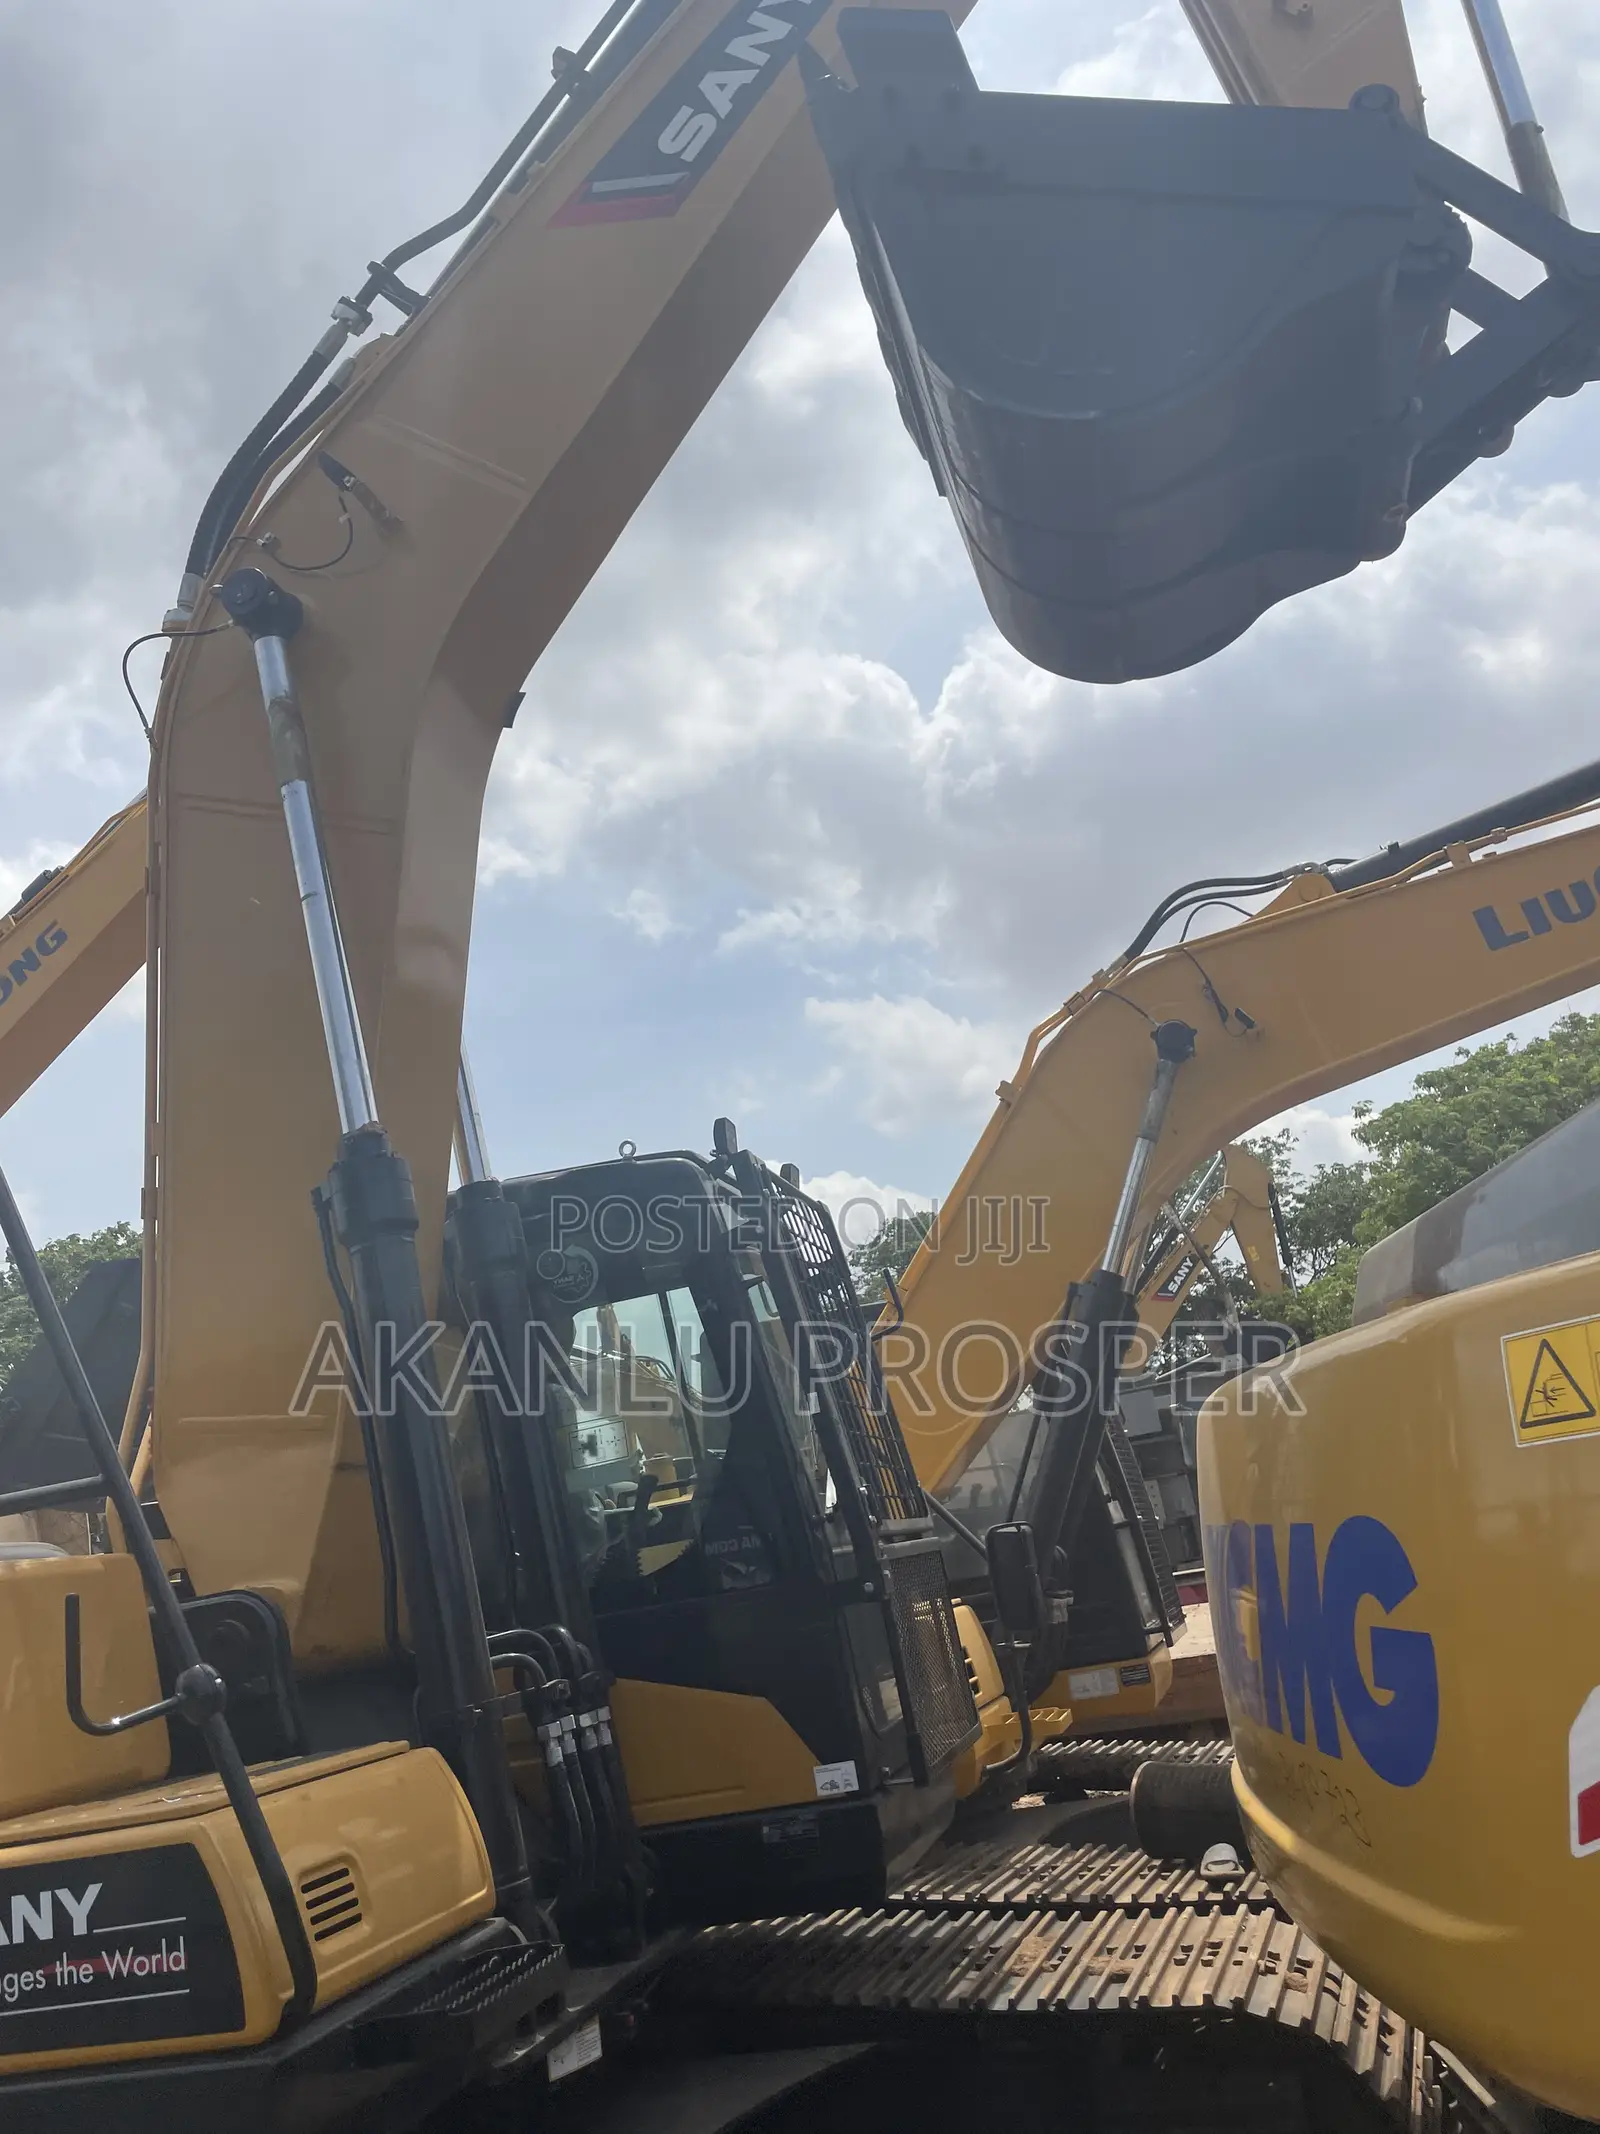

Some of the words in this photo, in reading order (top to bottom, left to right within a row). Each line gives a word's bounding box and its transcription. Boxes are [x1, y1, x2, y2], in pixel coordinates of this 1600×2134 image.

[658, 0, 812, 162] SAN
[1472, 865, 1600, 951] LIU
[1167, 1256, 1194, 1293] SANY
[0, 1882, 103, 1946] NY
[0, 1970, 46, 2003] ges
[55, 1951, 94, 1987] the
[101, 1935, 186, 1980] World
